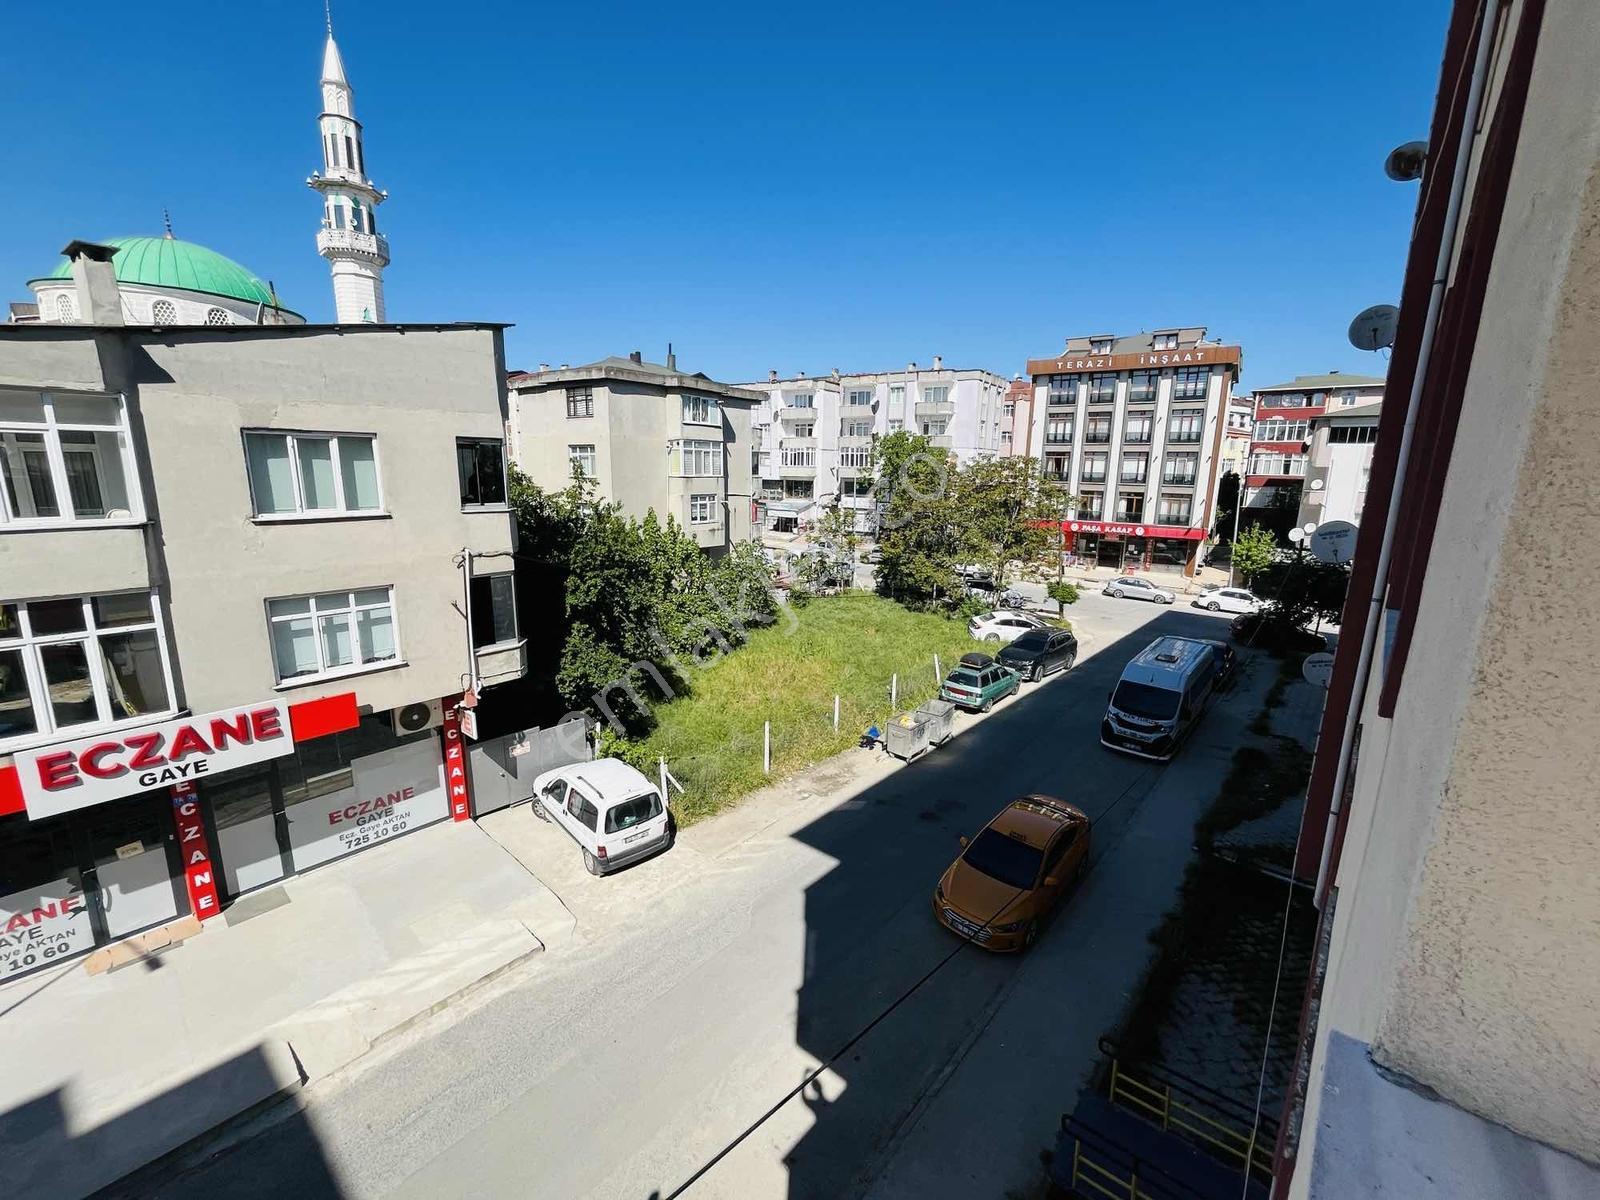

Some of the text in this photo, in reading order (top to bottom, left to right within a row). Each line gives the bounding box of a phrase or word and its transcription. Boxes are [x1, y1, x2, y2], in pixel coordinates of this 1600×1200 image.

[1057, 352, 1204, 369] TERAZİ İNŞAAT
[36, 706, 284, 791] ECZANE
[444, 709, 465, 814] ECZANE
[138, 759, 209, 787] GAYE
[328, 787, 415, 825] ECZANE
[356, 807, 394, 827] GAYE
[345, 821, 407, 849] 725 10 60
[360, 822, 381, 834] Gaye
[383, 811, 411, 826] AKTAN
[0, 896, 80, 936] ANE
[0, 926, 43, 948] AYE
[25, 928, 77, 953] AKTAN
[8, 942, 70, 971] 10 60
